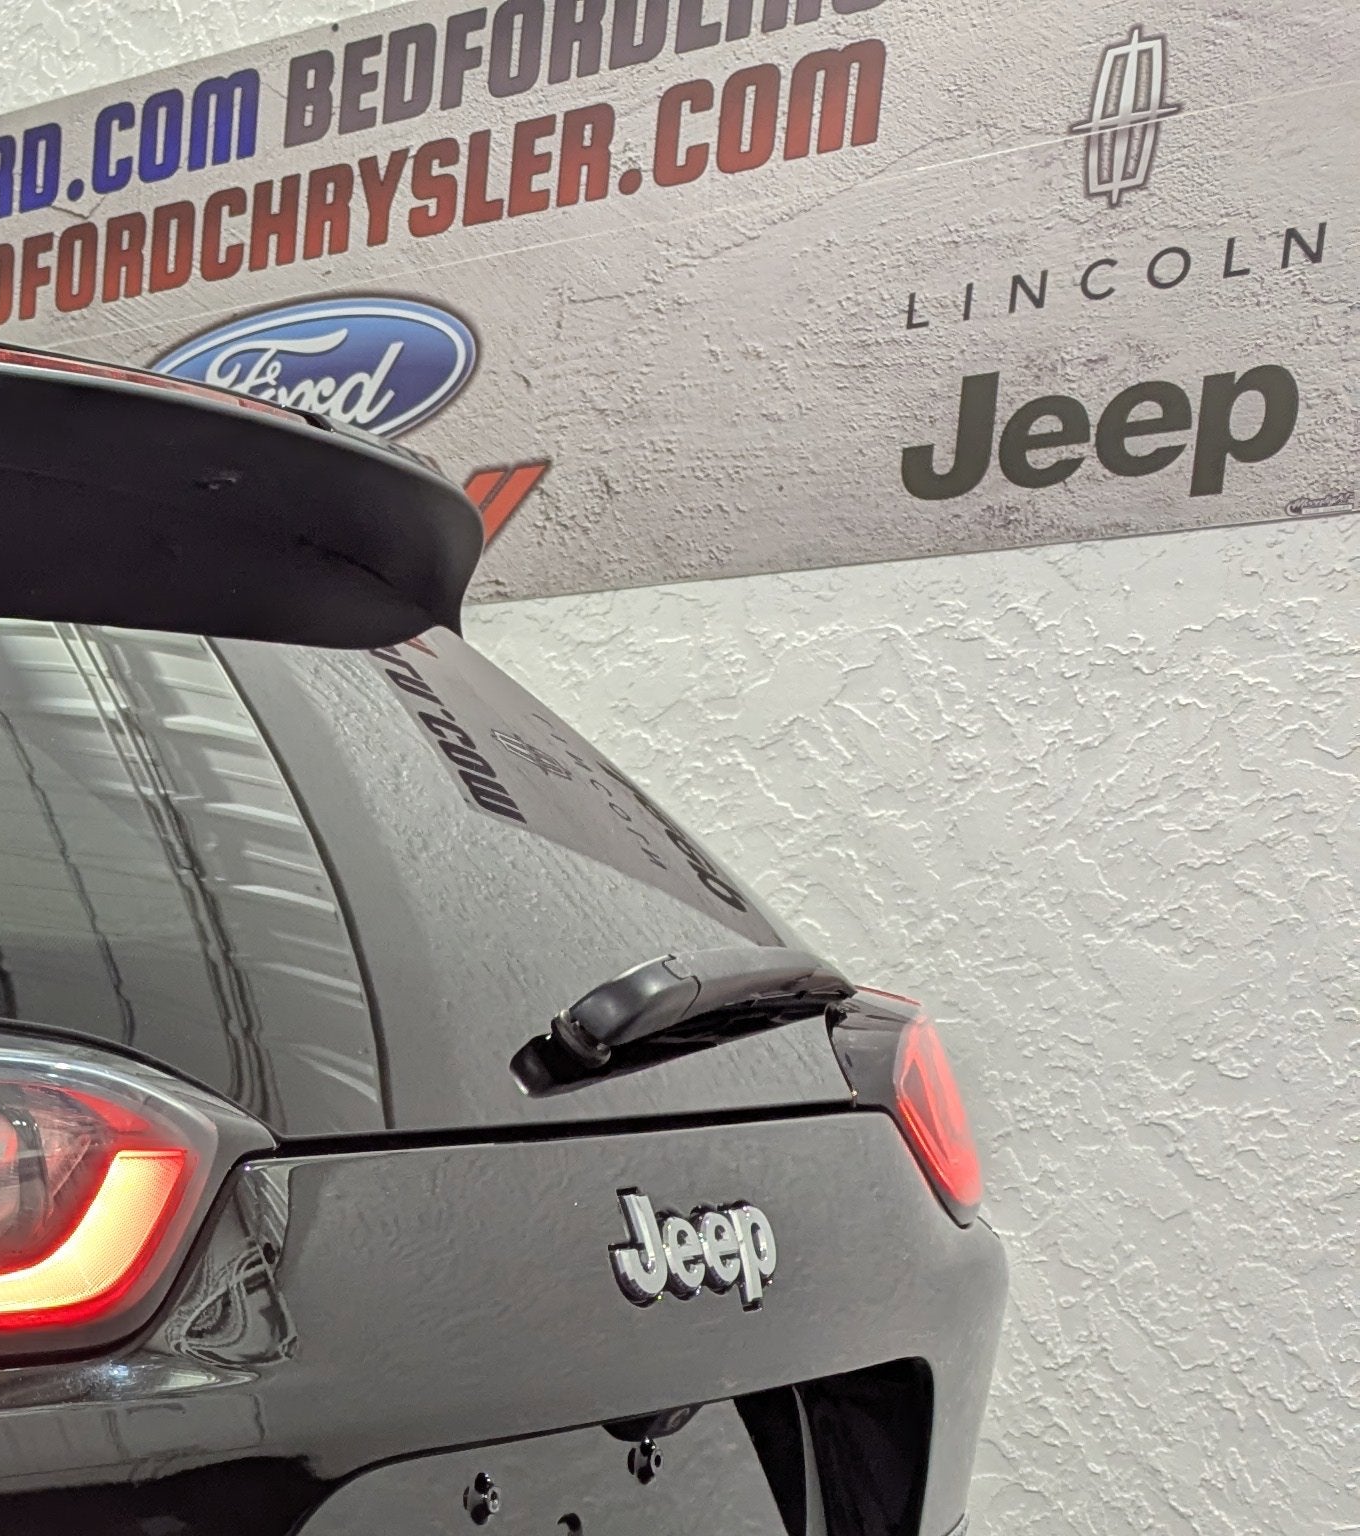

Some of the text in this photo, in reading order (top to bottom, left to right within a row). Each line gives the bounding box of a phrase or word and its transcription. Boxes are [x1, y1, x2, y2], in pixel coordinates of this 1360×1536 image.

[904, 221, 1328, 330] LINCOLN
[900, 363, 1301, 501] Jeep
[607, 1186, 777, 1311] Jeep
